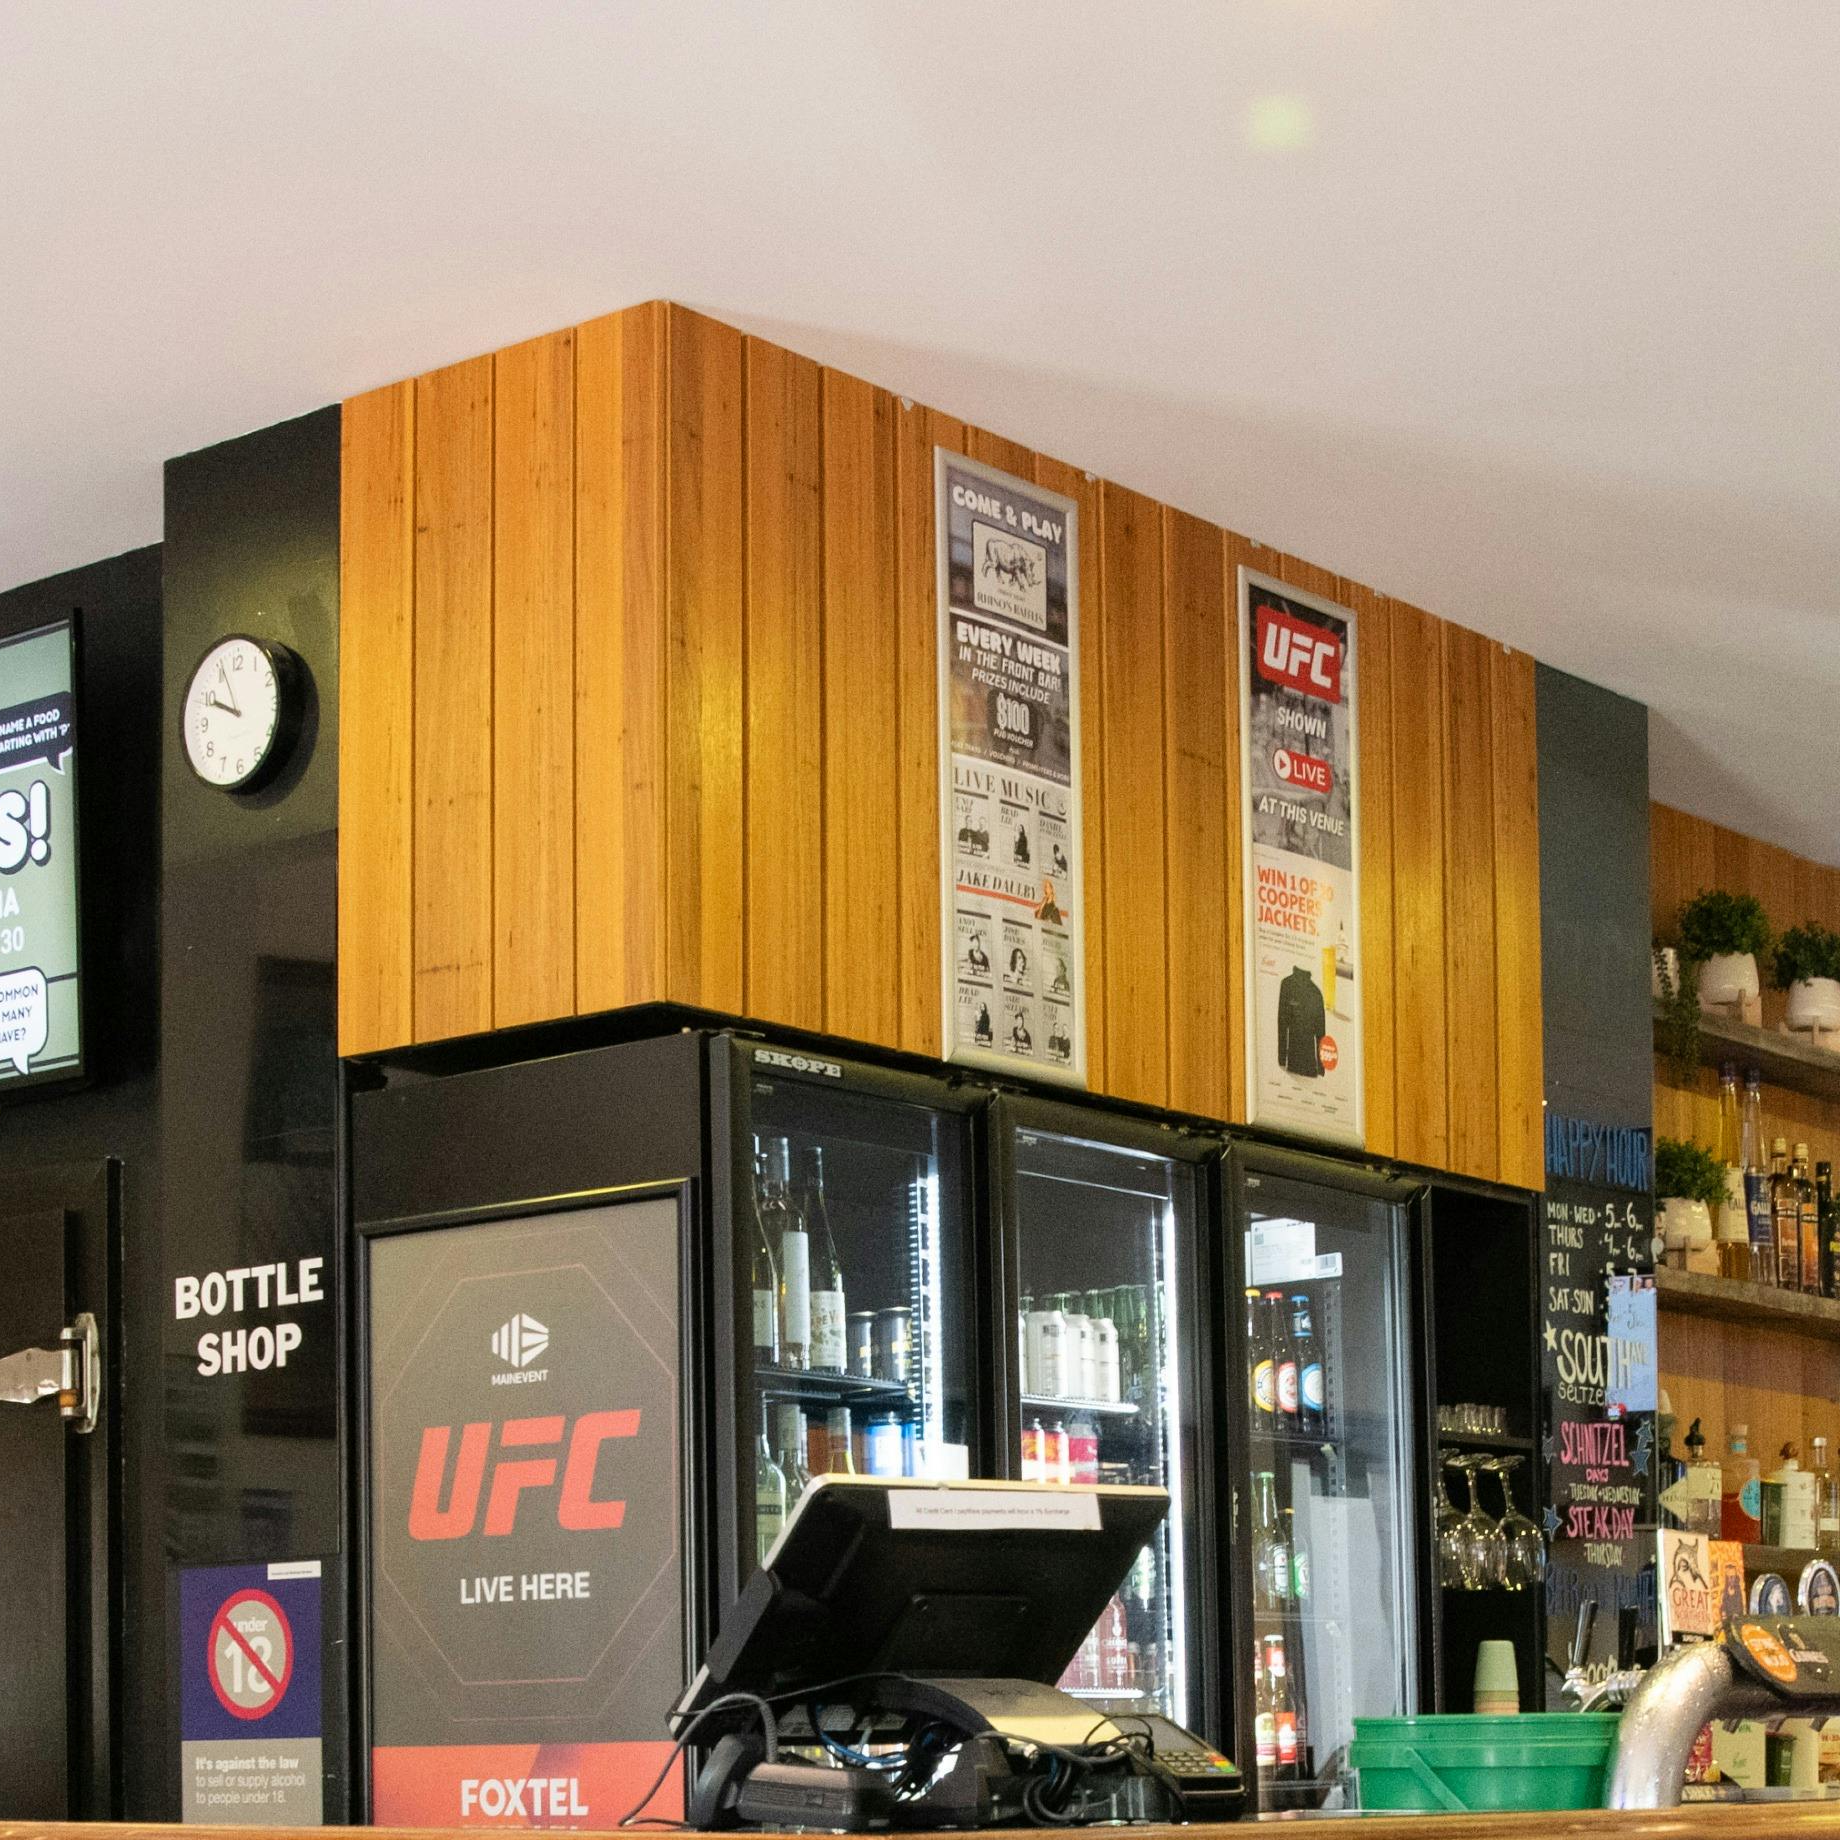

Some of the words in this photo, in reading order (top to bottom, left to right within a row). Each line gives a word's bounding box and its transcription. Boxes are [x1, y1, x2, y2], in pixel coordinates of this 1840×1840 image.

[953, 485, 1002, 520] COME
[1006, 505, 1017, 527] &
[1022, 511, 1062, 544] PLAY
[232, 655, 243, 671] 12
[956, 622, 1013, 656] EVERY
[1017, 641, 1061, 675] WEEK
[959, 645, 972, 662] IN
[976, 651, 998, 669] THE
[1002, 659, 1035, 682] FRONT
[1263, 622, 1334, 689] UFC
[971, 668, 1007, 690] PRIZES
[1008, 680, 1050, 705] INCLUDE
[26, 717, 33, 728] A
[33, 708, 60, 726] FOOD
[997, 693, 1030, 735] $100
[1277, 706, 1326, 739] SHOWN
[33, 726, 58, 744] WITH
[954, 767, 995, 793] LIVE
[1001, 778, 1051, 809] MUSIC
[1293, 761, 1326, 786] LIVE
[1259, 795, 1277, 814] AT
[1279, 801, 1307, 826] THIS
[1310, 809, 1344, 837] VENUE
[956, 870, 990, 890] JAKE
[1257, 865, 1287, 889] WIN
[1300, 877, 1317, 896] OF
[1258, 886, 1322, 916] COOPERS
[0, 926, 25, 953] 30
[2, 1006, 32, 1023] MANY
[755, 1049, 842, 1078] SKOPE
[1546, 1113, 1604, 1182] HAPPY
[1606, 1126, 1649, 1192] HOUR
[1548, 1224, 1584, 1249] THURS
[1549, 1252, 1570, 1277] FRI
[175, 1256, 324, 1320] BOTTLE
[197, 1323, 302, 1377] SHOP
[1556, 1329, 1632, 1390] SOUTH
[491, 1369, 549, 1386] MAINEVENT
[1560, 1421, 1630, 1467] SCHNITZEL
[408, 1408, 641, 1541] UFC
[1586, 1468, 1609, 1483] DAYS
[1569, 1483, 1598, 1501] TUESDAY
[1566, 1505, 1610, 1539] STEAK
[1612, 1508, 1635, 1539] DAY
[1586, 1543, 1623, 1568] THURSDAY
[461, 1575, 514, 1605] LIVE
[521, 1571, 590, 1601] HERE
[1673, 1588, 1709, 1610] GREAT
[223, 1636, 276, 1694] 18
[196, 1756, 213, 1770] It's
[215, 1757, 255, 1773] against
[258, 1757, 277, 1769] the
[279, 1756, 299, 1769] law
[196, 1775, 205, 1787] to
[207, 1774, 223, 1786] sell
[237, 1774, 269, 1790] supply
[271, 1773, 306, 1786] alcohol
[461, 1778, 589, 1816] FOXTEL
[196, 1792, 205, 1804] to
[207, 1792, 240, 1807] people
[242, 1790, 270, 1804] under
